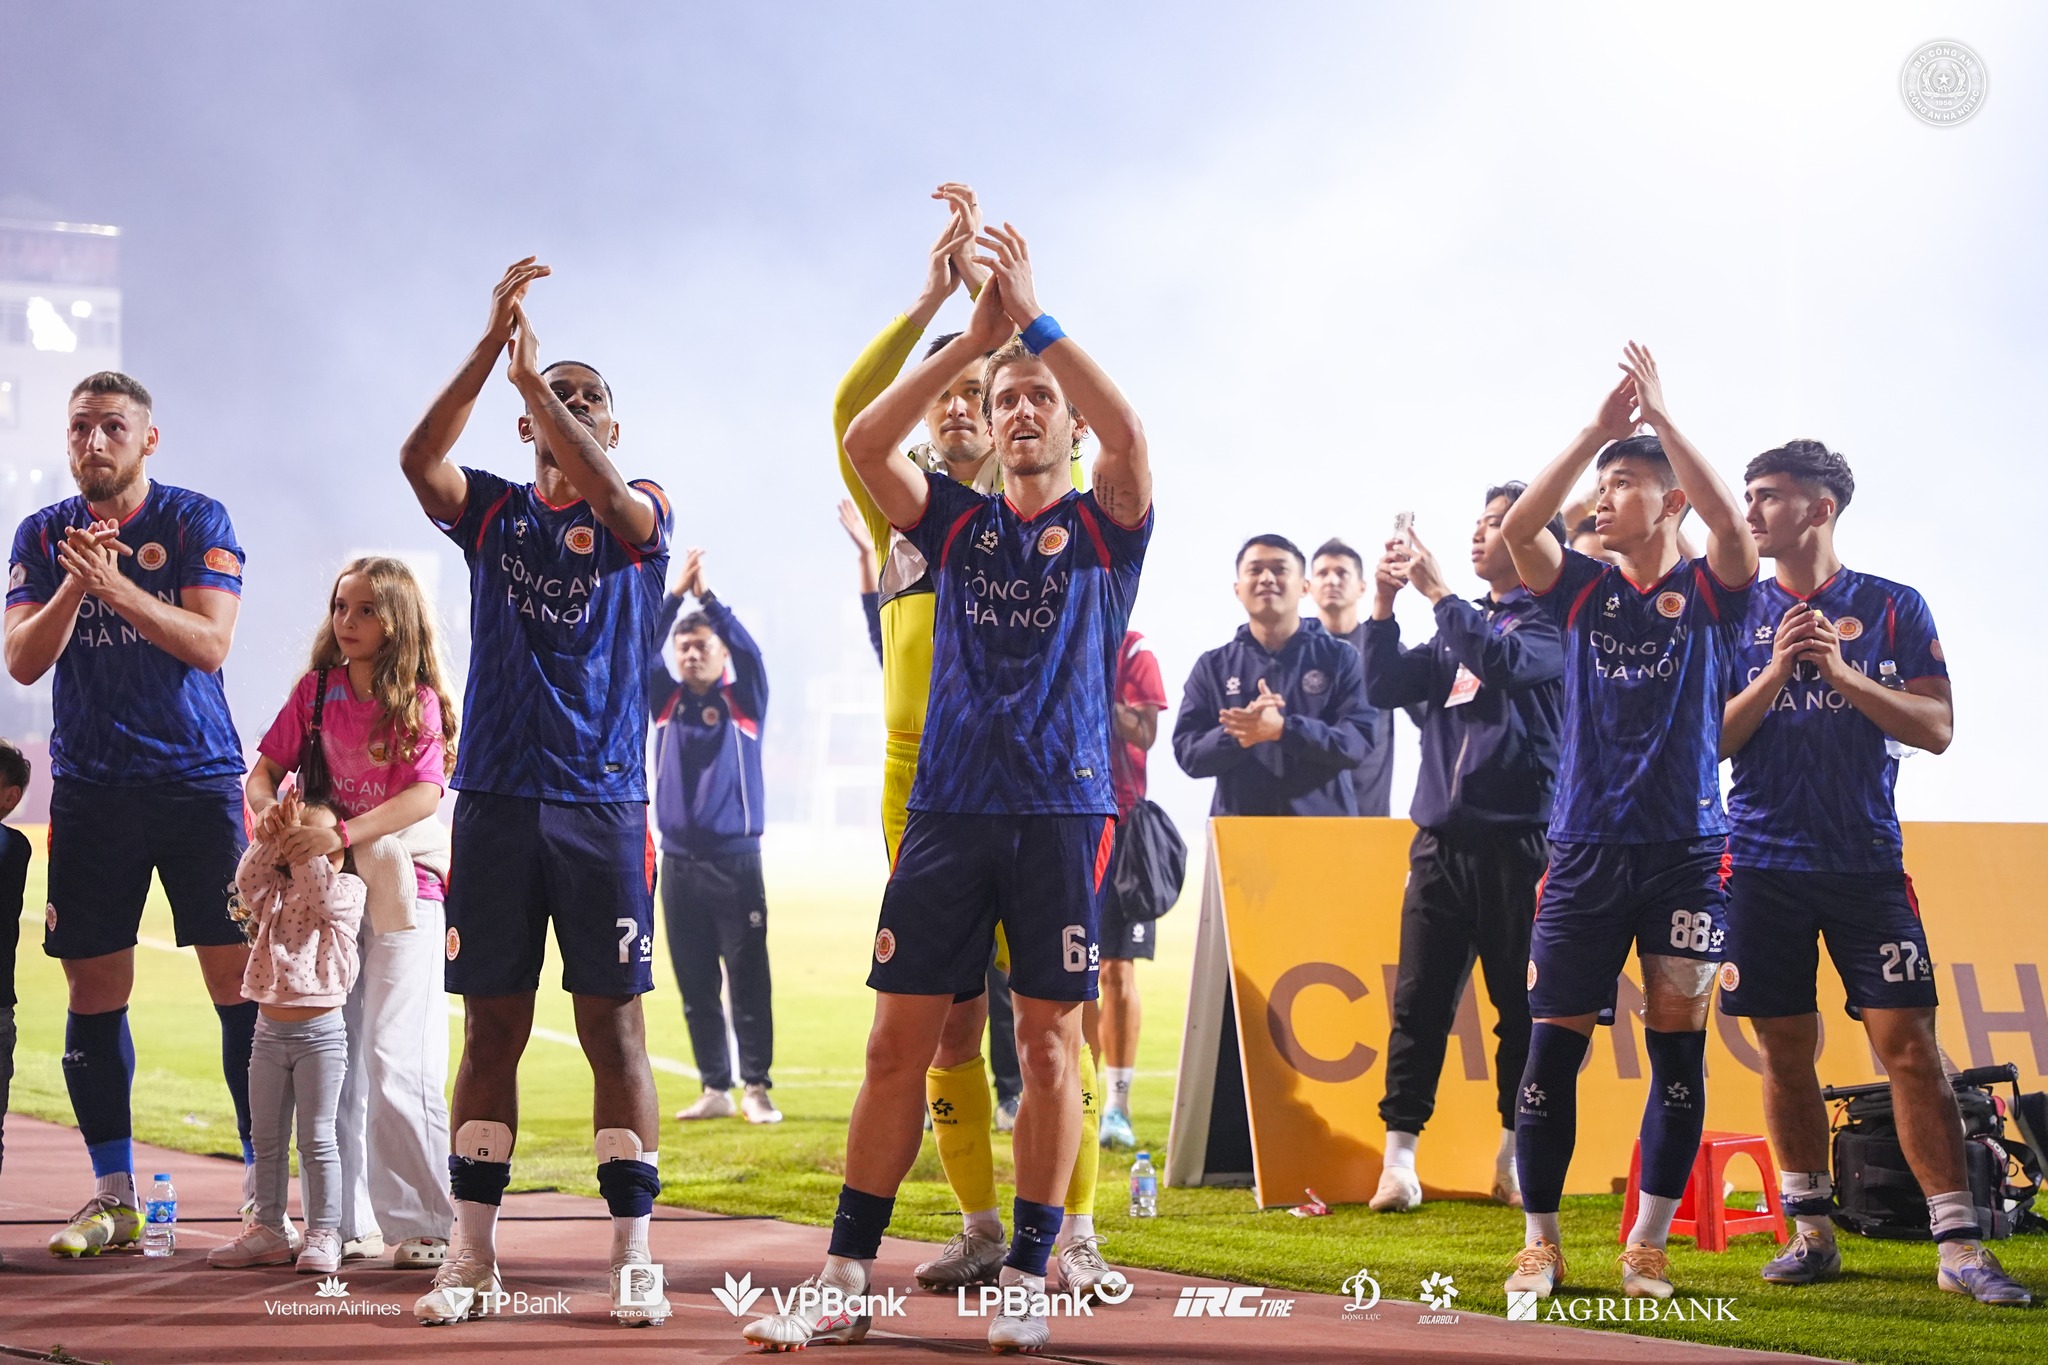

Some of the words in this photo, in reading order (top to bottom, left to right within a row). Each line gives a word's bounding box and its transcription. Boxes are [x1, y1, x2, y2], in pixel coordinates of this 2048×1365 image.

[501, 553, 562, 597] CÔNG
[568, 567, 600, 599] AN
[541, 601, 590, 630] NỘI
[965, 600, 999, 627] HÀ
[78, 624, 114, 648] HÀ
[1595, 658, 1629, 681] HÀ
[1637, 652, 1680, 682] NỘI
[359, 781, 387, 797] AN
[616, 917, 639, 964] 7
[1062, 924, 1088, 973] 6
[1670, 909, 1713, 952] 88
[1879, 941, 1919, 983] 27
